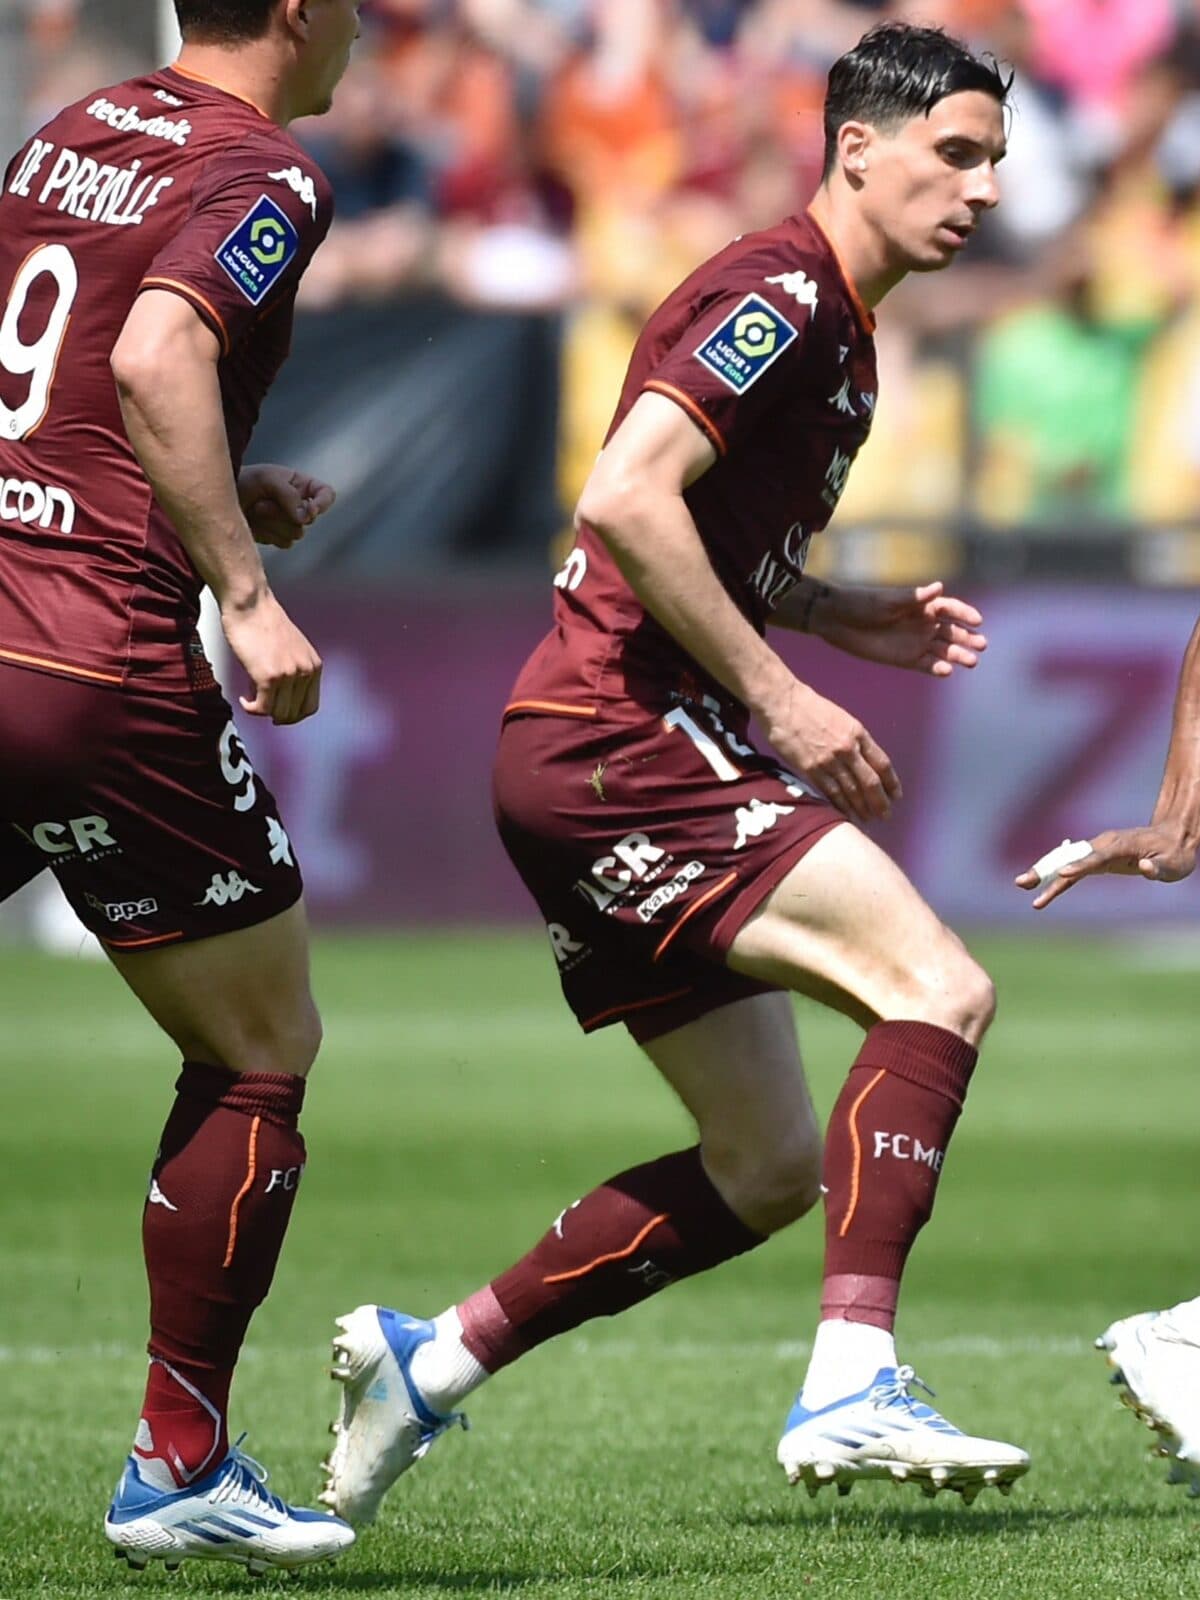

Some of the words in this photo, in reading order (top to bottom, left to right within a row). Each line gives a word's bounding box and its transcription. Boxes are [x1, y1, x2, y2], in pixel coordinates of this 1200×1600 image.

[8, 139, 54, 197] DE
[231, 245, 260, 276] LIGUE
[257, 273, 265, 283] 1
[0, 243, 78, 441] 9
[705, 346, 727, 367] Uber
[723, 362, 744, 384] Eats
[715, 340, 747, 369] LIGUE
[743, 365, 752, 374] 1
[0, 477, 75, 535] con
[30, 815, 118, 854] CR
[637, 860, 706, 923] Kappa
